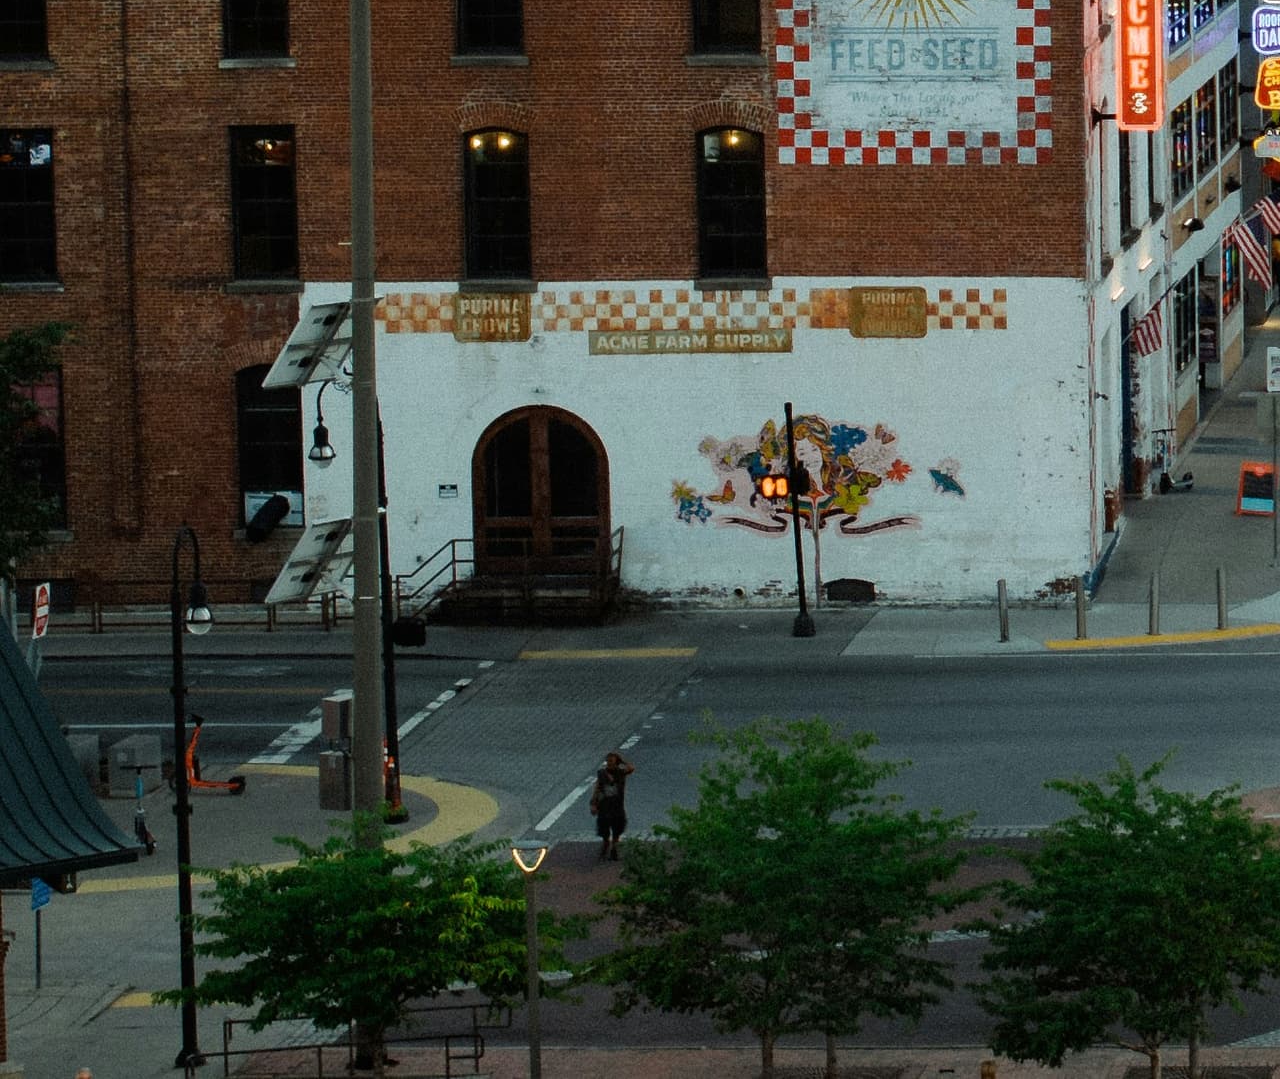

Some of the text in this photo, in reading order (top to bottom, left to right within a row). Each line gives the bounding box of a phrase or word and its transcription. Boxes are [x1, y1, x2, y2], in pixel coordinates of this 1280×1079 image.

[830, 38, 905, 71] FEED
[923, 38, 998, 72] SEED
[460, 298, 522, 315] PURINA
[460, 317, 521, 334] CHOWS
[597, 333, 786, 350] ACME FARM SUPPLY
